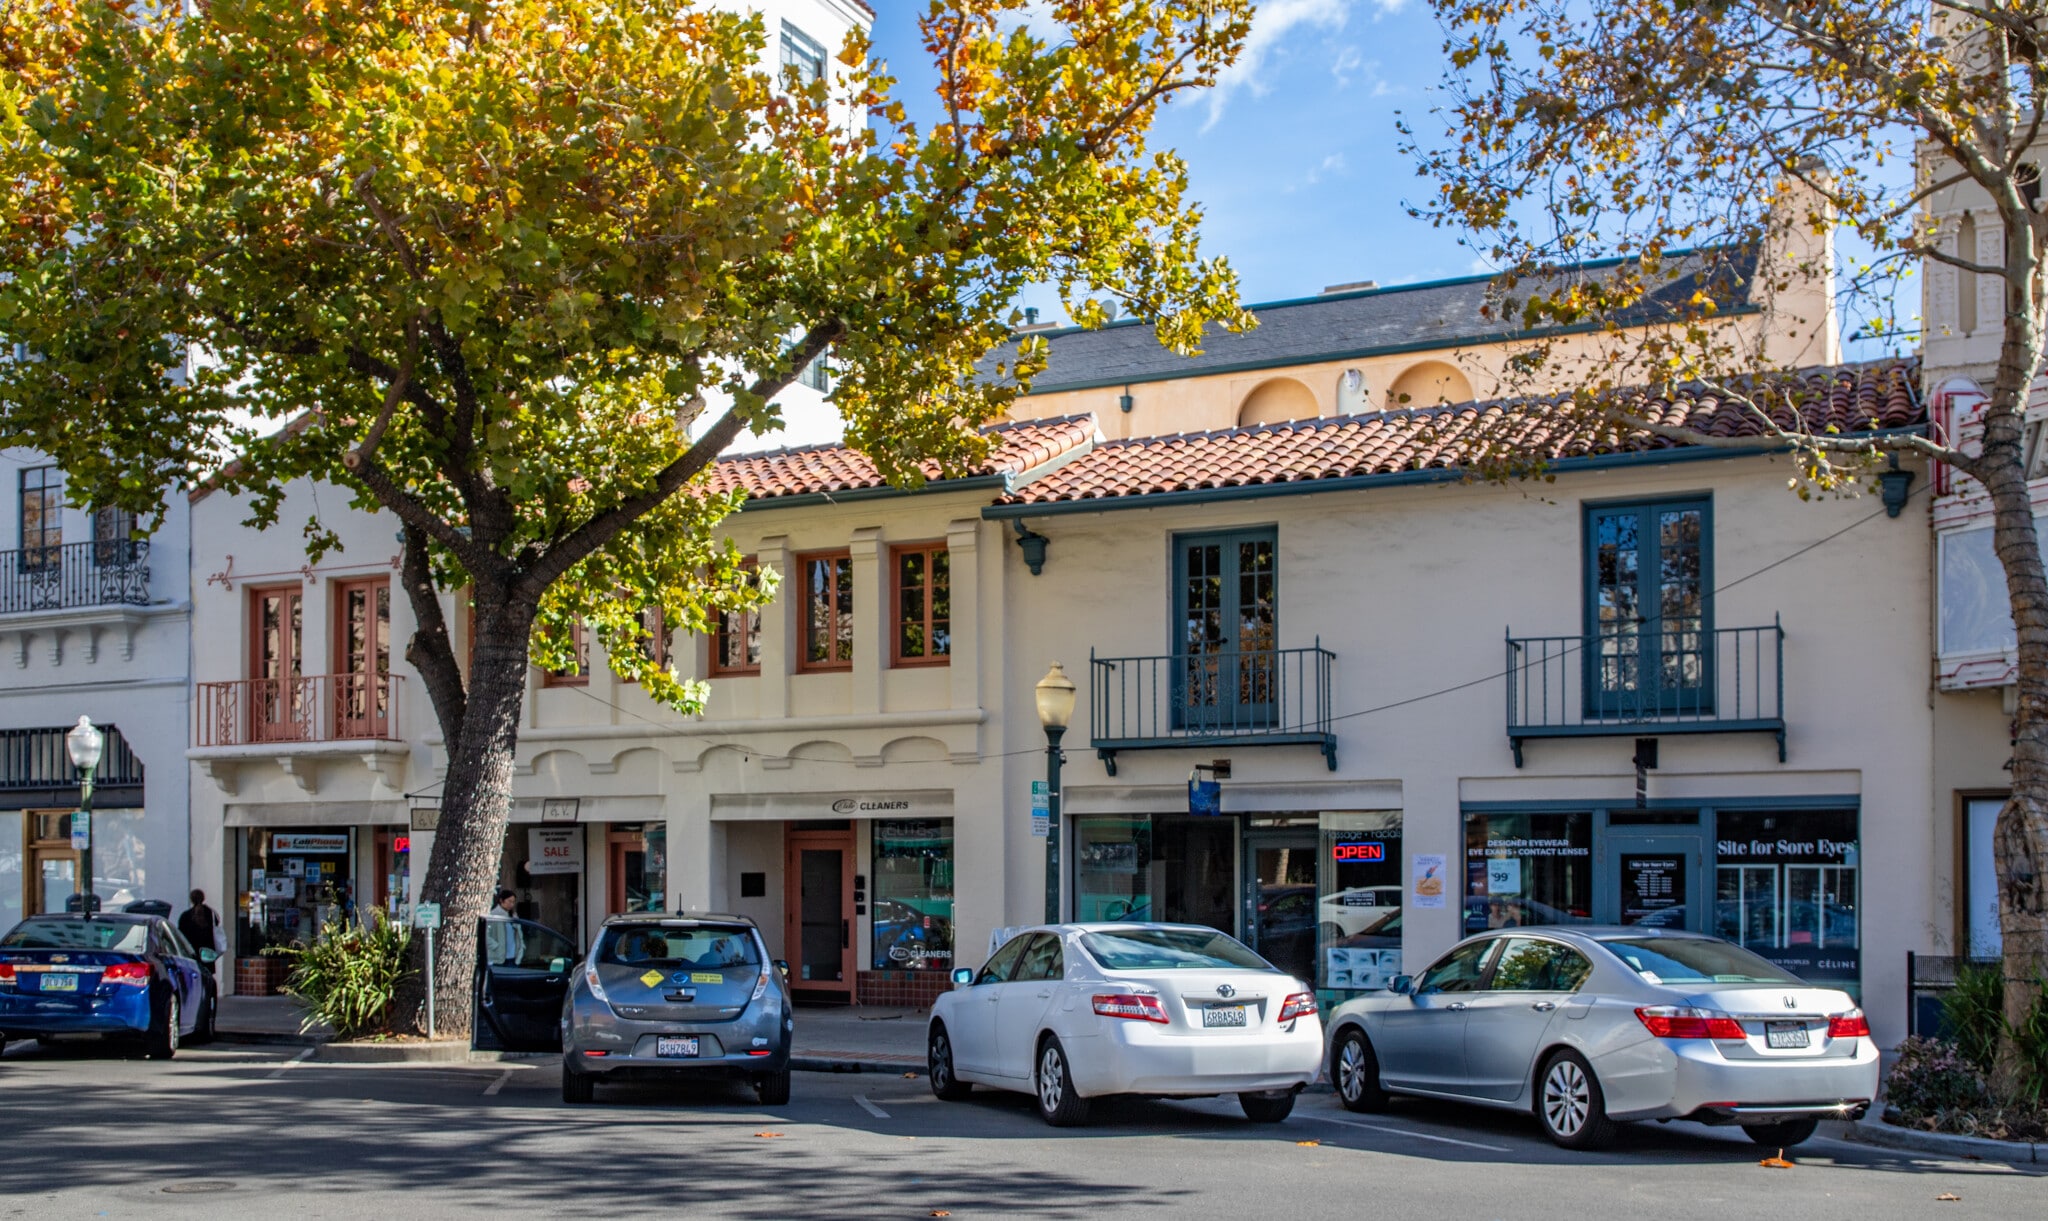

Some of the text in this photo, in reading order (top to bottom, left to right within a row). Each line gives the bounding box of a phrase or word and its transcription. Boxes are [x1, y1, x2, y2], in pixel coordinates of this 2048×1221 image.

[860, 801, 909, 810] CLEANERS
[544, 846, 570, 857] SALE
[1333, 845, 1381, 859] OPEN
[1717, 839, 1855, 857] Site for Sore Eyes
[911, 950, 952, 958] CLEANERS
